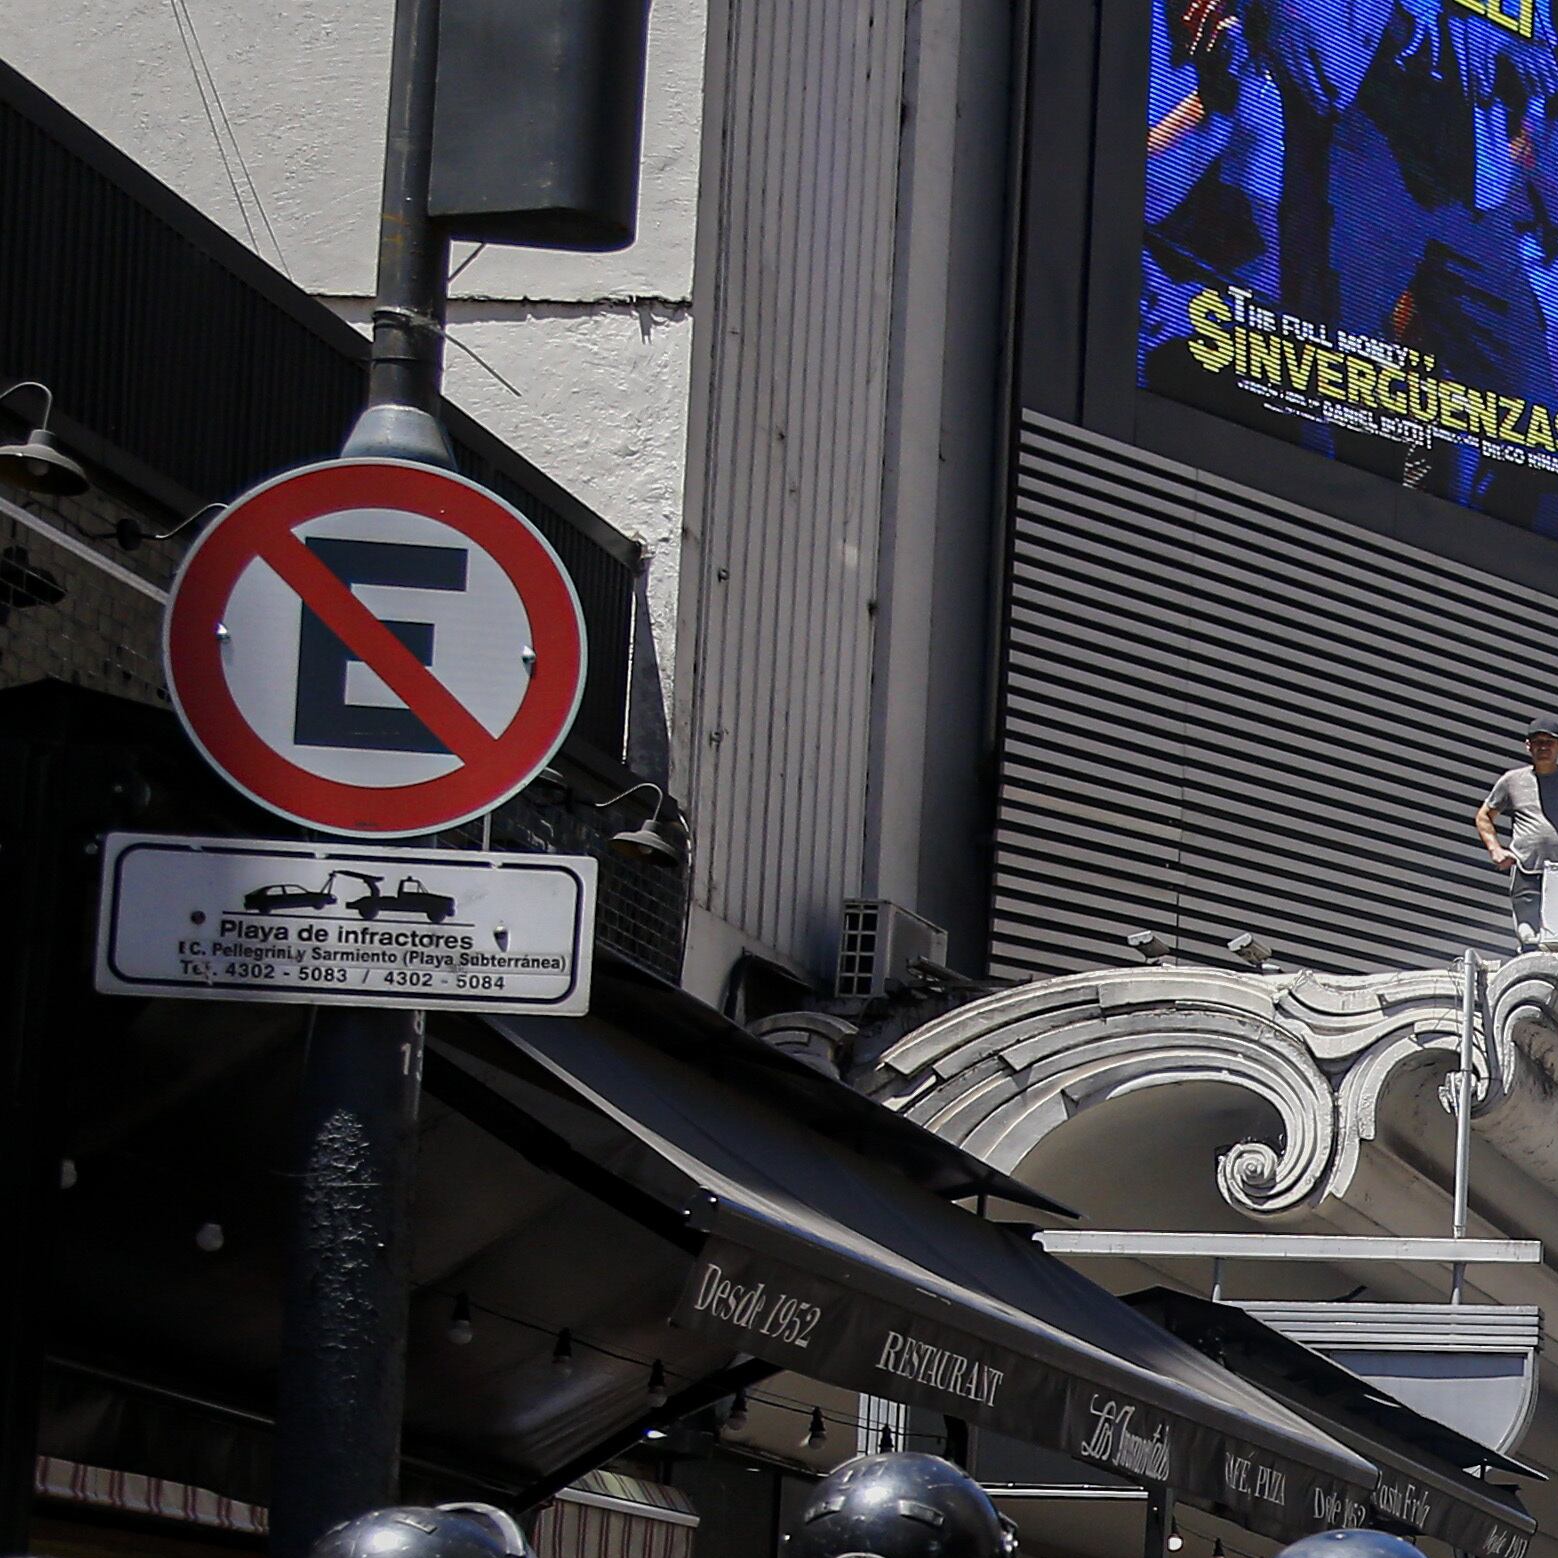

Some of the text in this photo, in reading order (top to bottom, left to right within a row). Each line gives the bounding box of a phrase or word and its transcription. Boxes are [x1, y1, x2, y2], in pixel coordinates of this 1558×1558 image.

[220, 919, 473, 949] Playa de infractores
[311, 946, 397, 963] Sarmiento
[403, 951, 454, 969] (Playa
[460, 952, 566, 972] Subterránea)
[225, 962, 275, 979] 4302
[299, 967, 347, 982] 5083
[384, 971, 432, 986] 4302
[456, 975, 505, 990] 5084
[759, 1293, 822, 1349] 1952
[875, 1330, 1004, 1408] RESTAURANT
